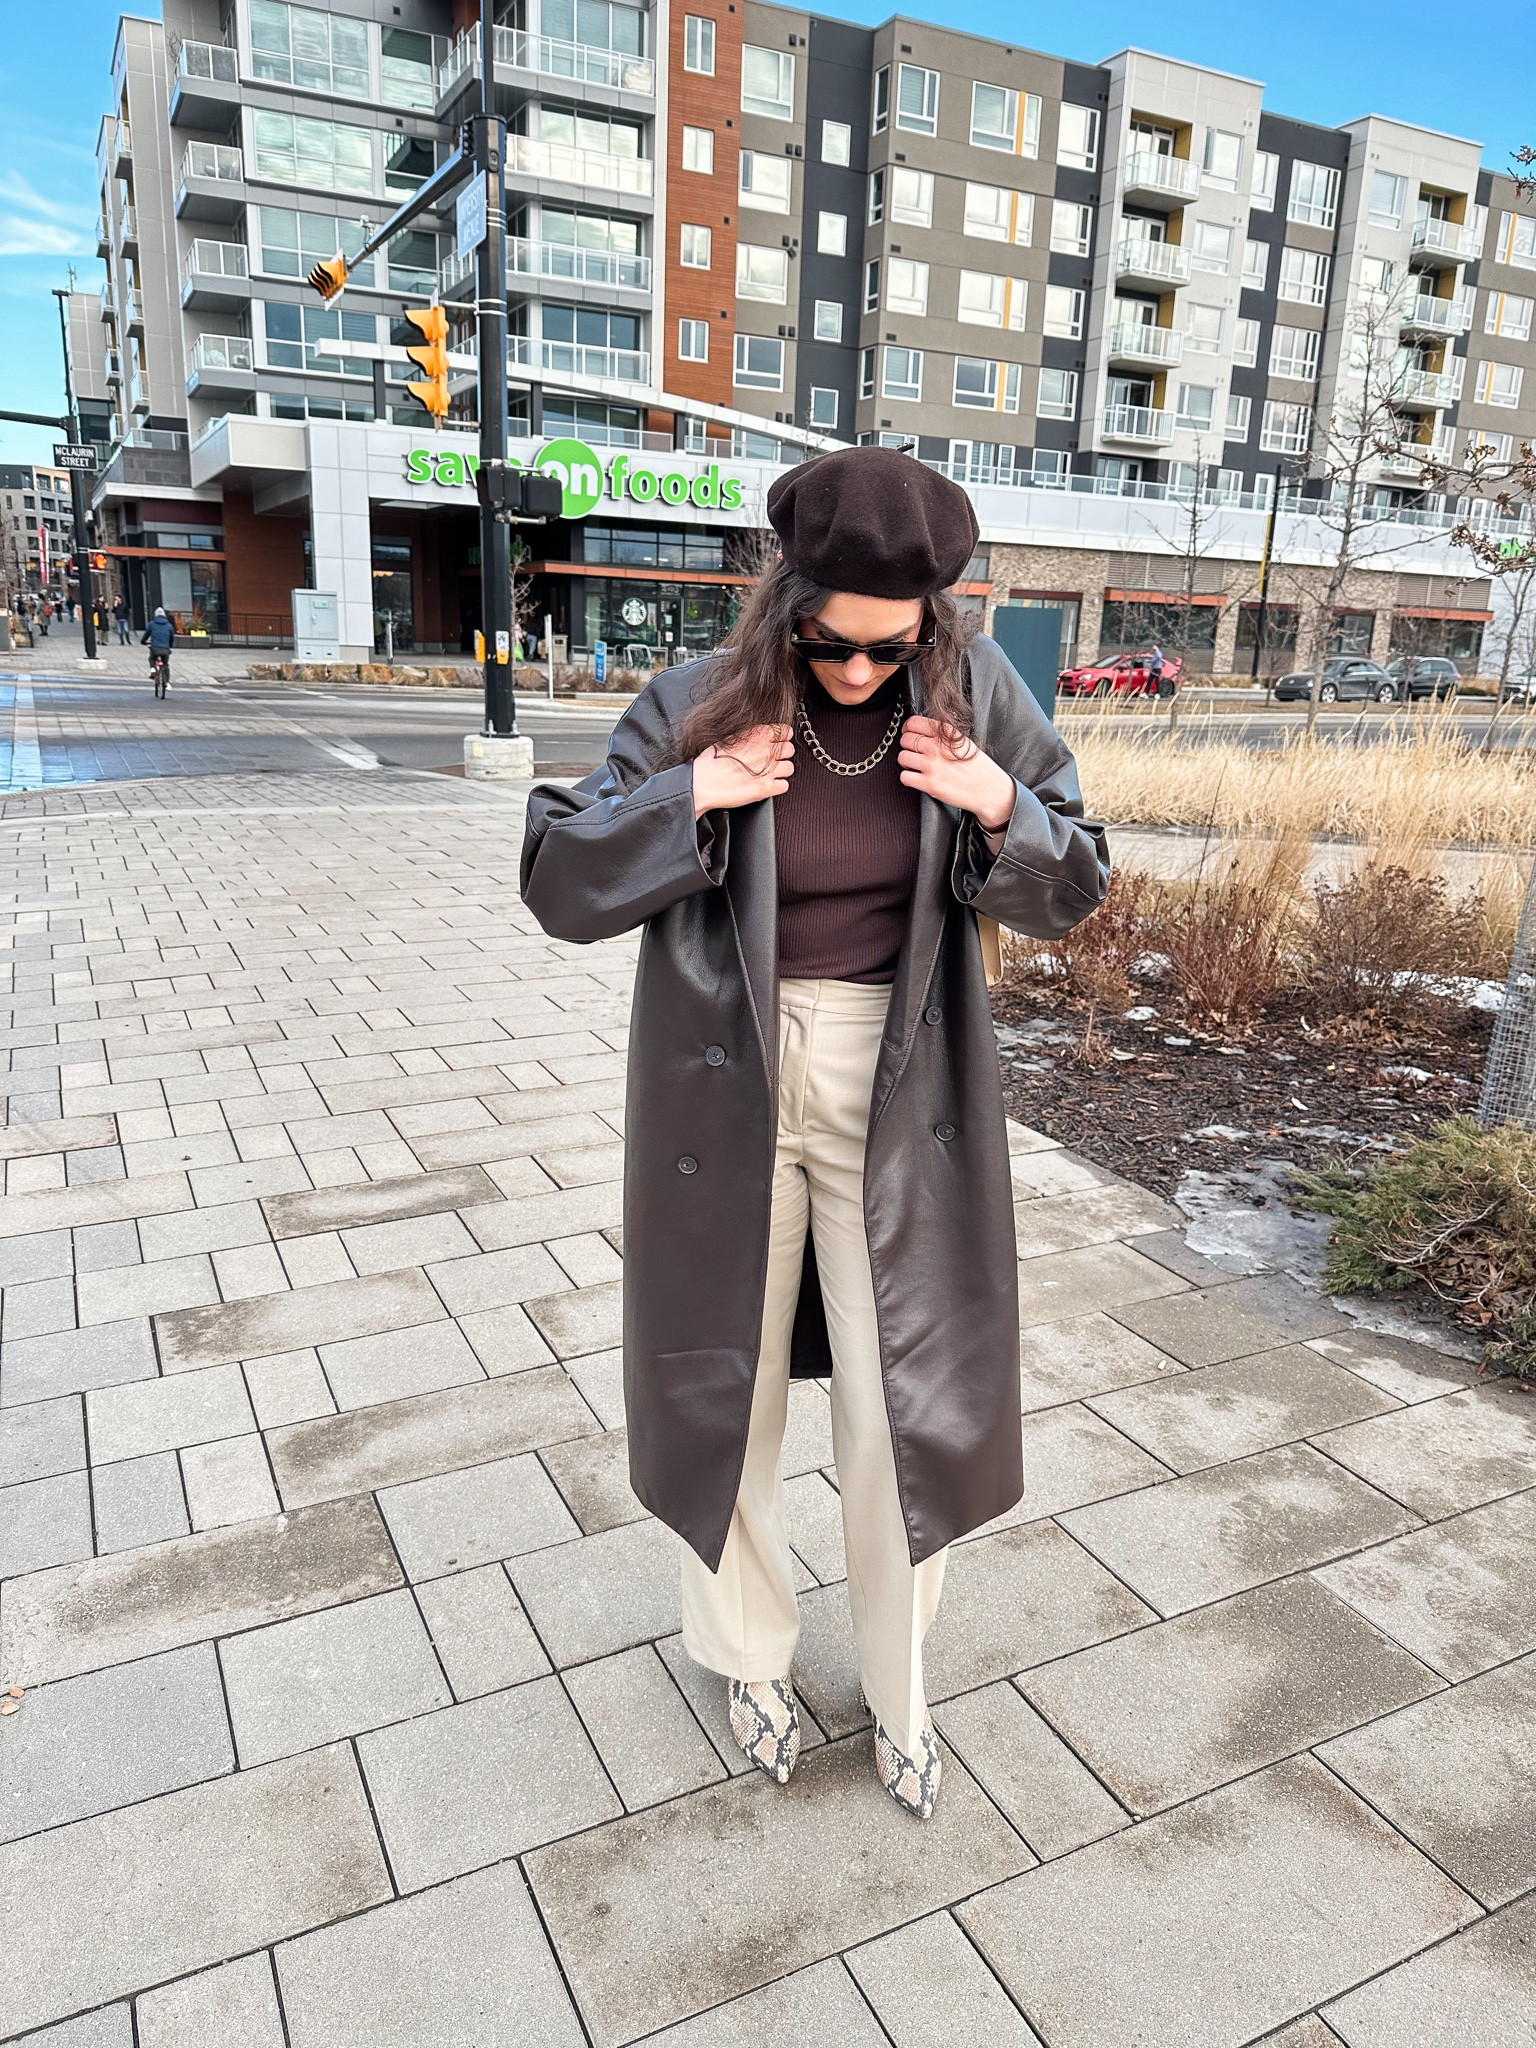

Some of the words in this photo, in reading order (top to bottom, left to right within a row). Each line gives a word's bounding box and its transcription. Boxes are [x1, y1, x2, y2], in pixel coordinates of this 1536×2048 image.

[55, 446, 94, 457] MCLAURIN
[61, 456, 89, 467] STREET
[608, 454, 743, 510] foods
